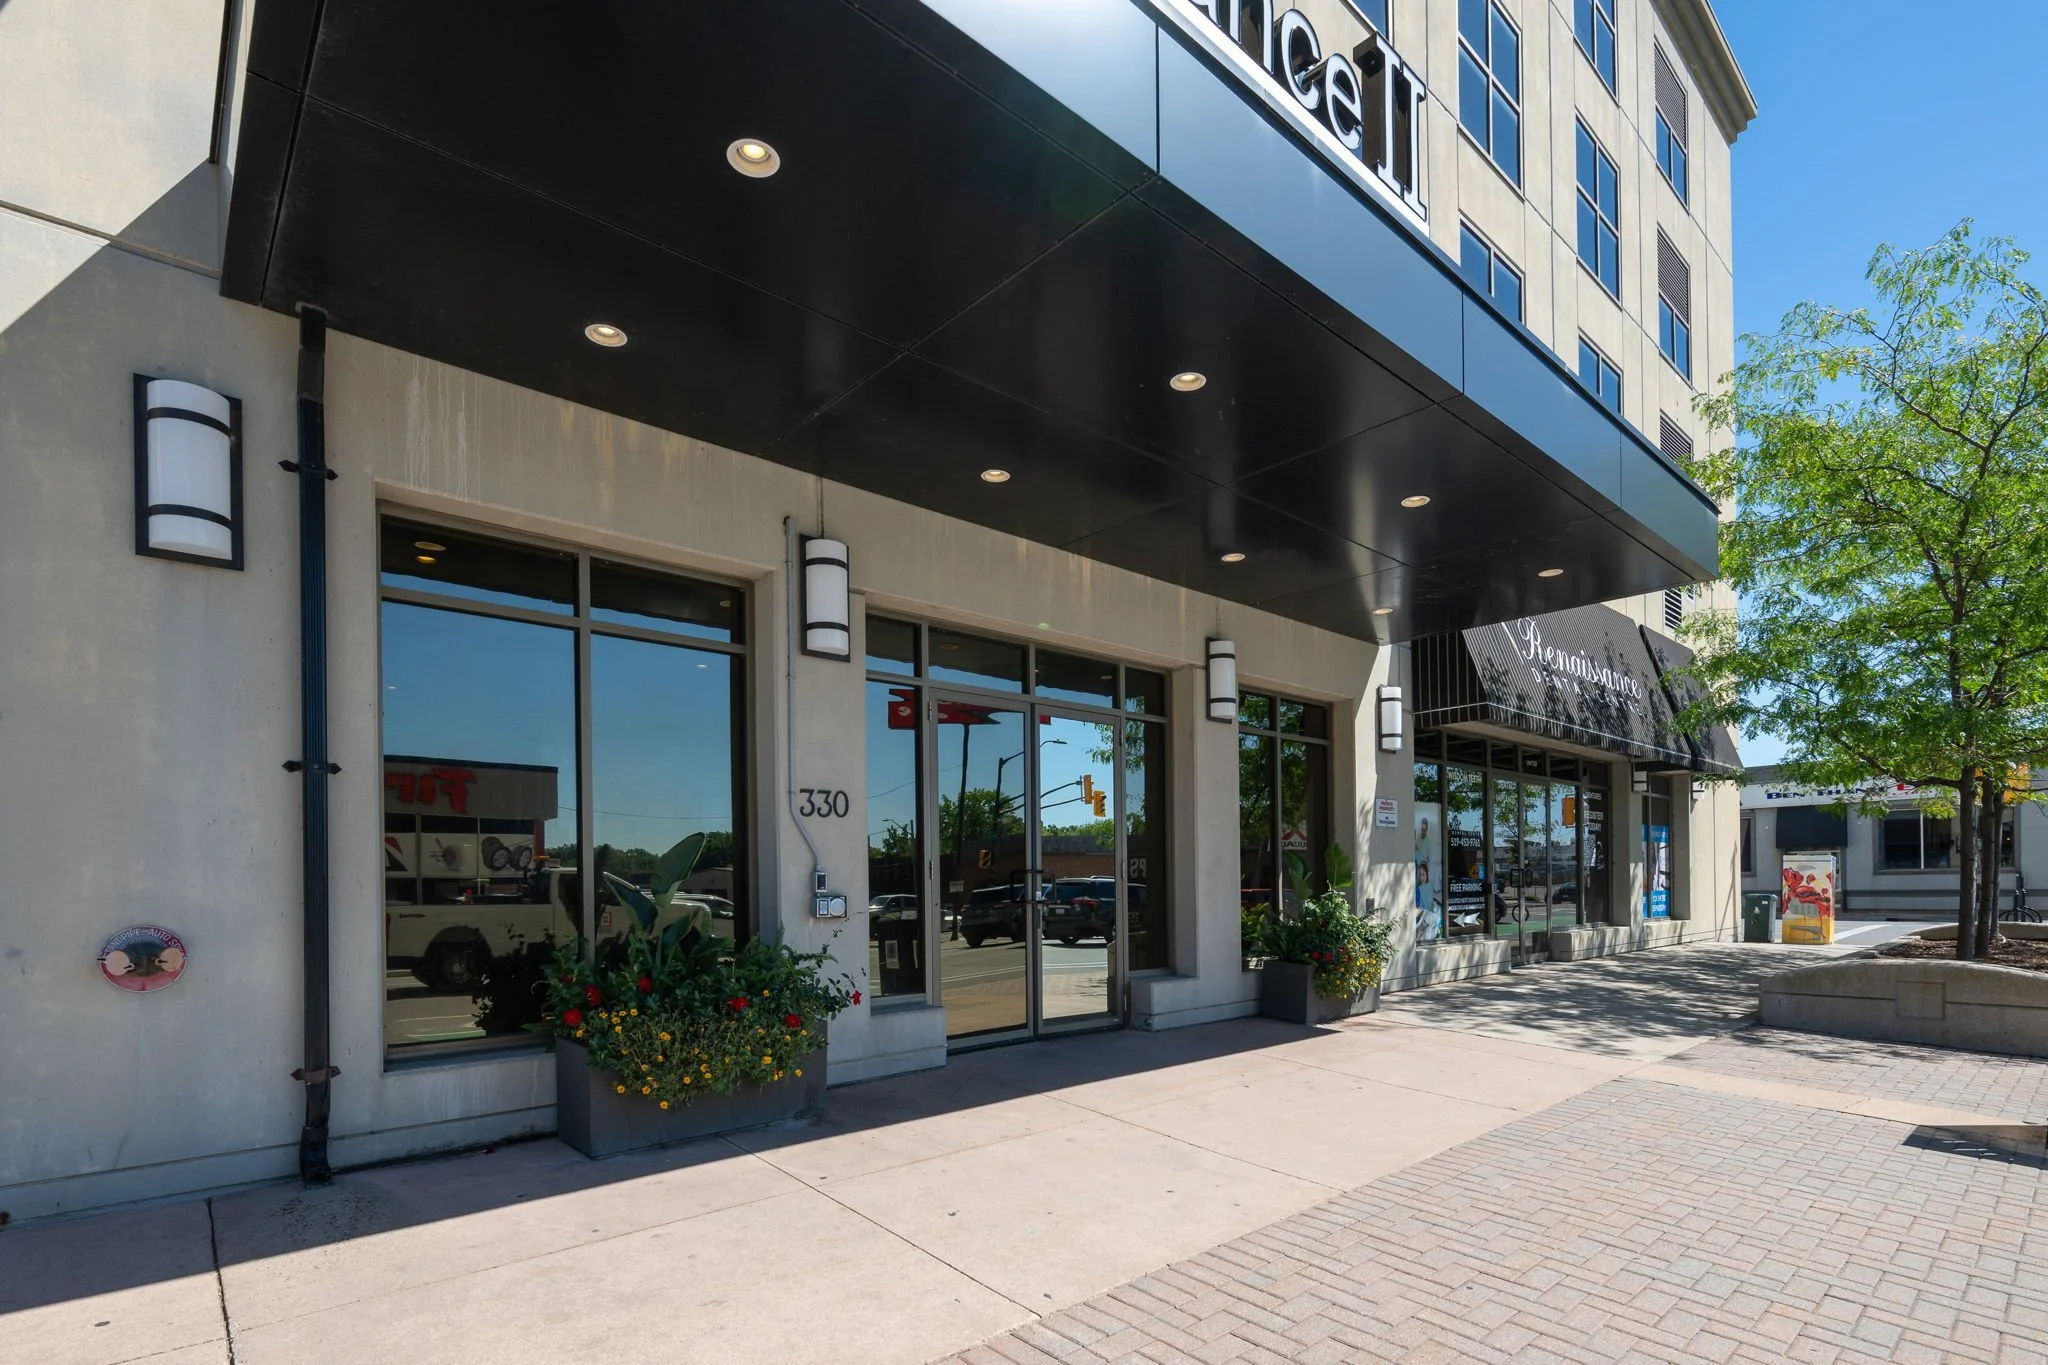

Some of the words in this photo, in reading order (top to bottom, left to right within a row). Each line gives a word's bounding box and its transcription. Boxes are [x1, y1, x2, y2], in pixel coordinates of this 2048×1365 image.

[1518, 617, 1642, 698] Renaissance
[1531, 667, 1589, 699] DENTAL
[1596, 690, 1643, 716] CENTRE
[800, 788, 849, 818] 330
[1450, 883, 1462, 892] FREE
[1462, 883, 1483, 892] PARKING
